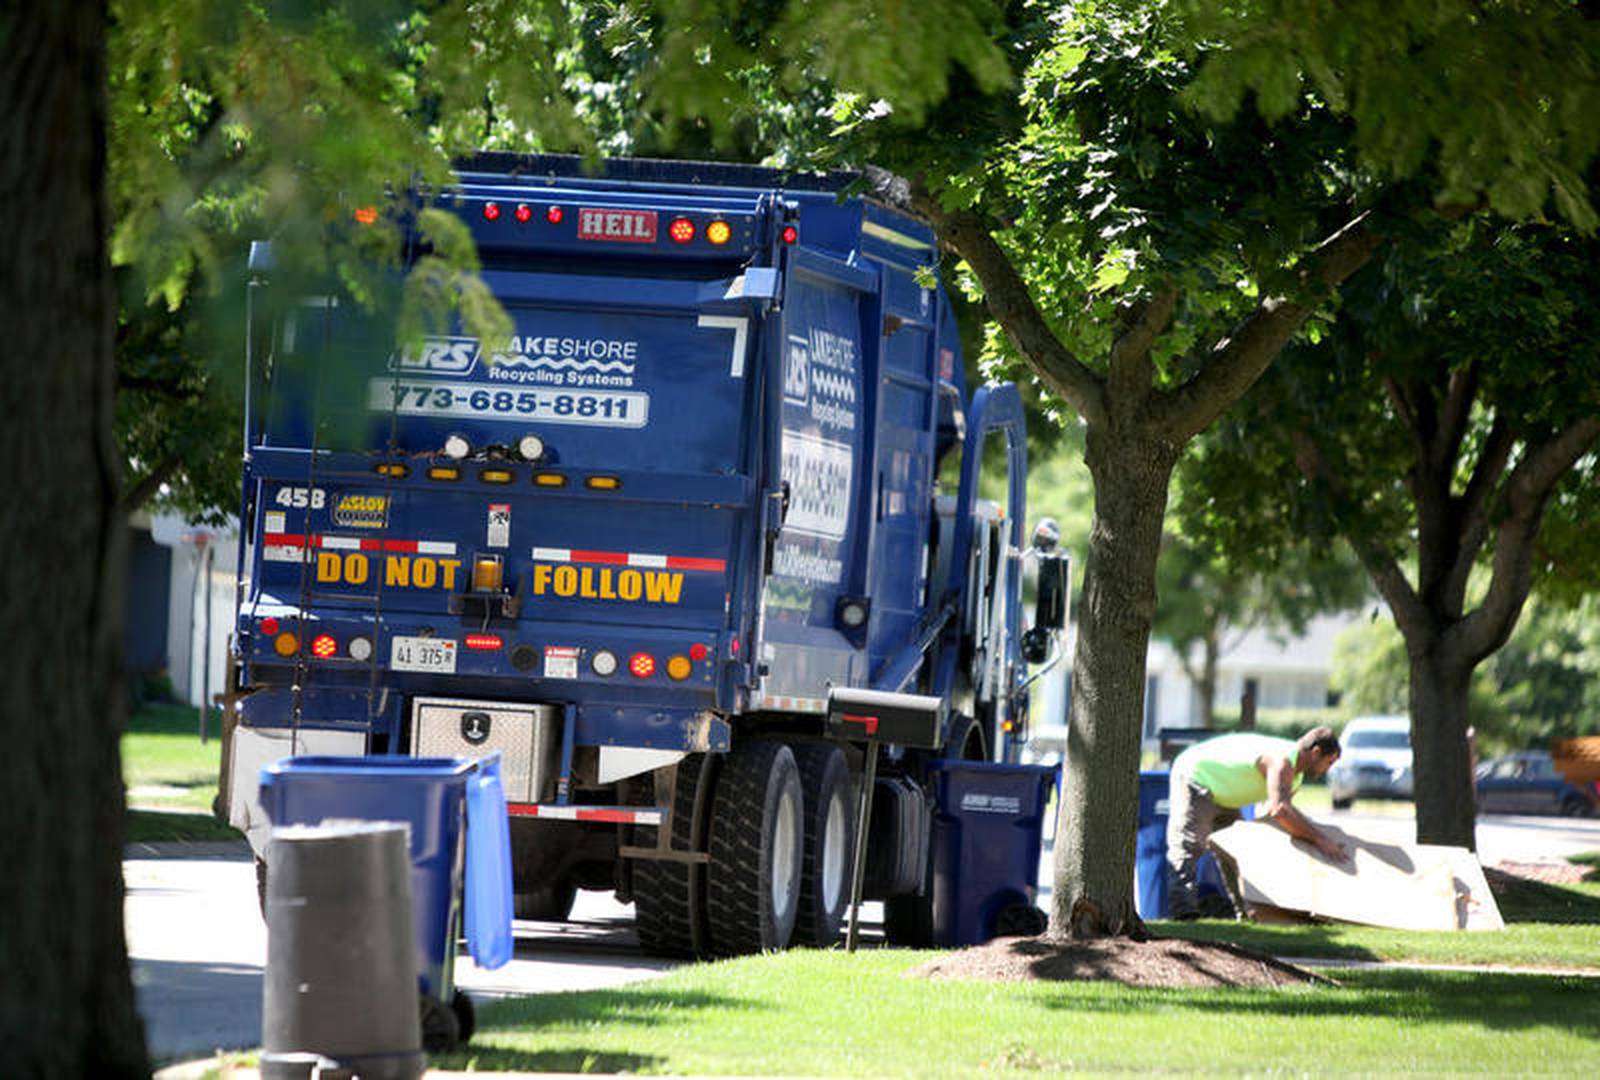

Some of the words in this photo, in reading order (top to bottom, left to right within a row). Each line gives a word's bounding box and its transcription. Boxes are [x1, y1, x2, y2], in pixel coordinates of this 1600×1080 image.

[583, 213, 652, 237] HEIL
[494, 336, 638, 360] AKESHORE
[489, 366, 563, 384] Recycling
[566, 371, 633, 386] Systems
[390, 384, 629, 419] 773-685-8811
[316, 552, 369, 584] DO
[385, 555, 462, 589] NOT
[533, 564, 684, 604] FOLLOW
